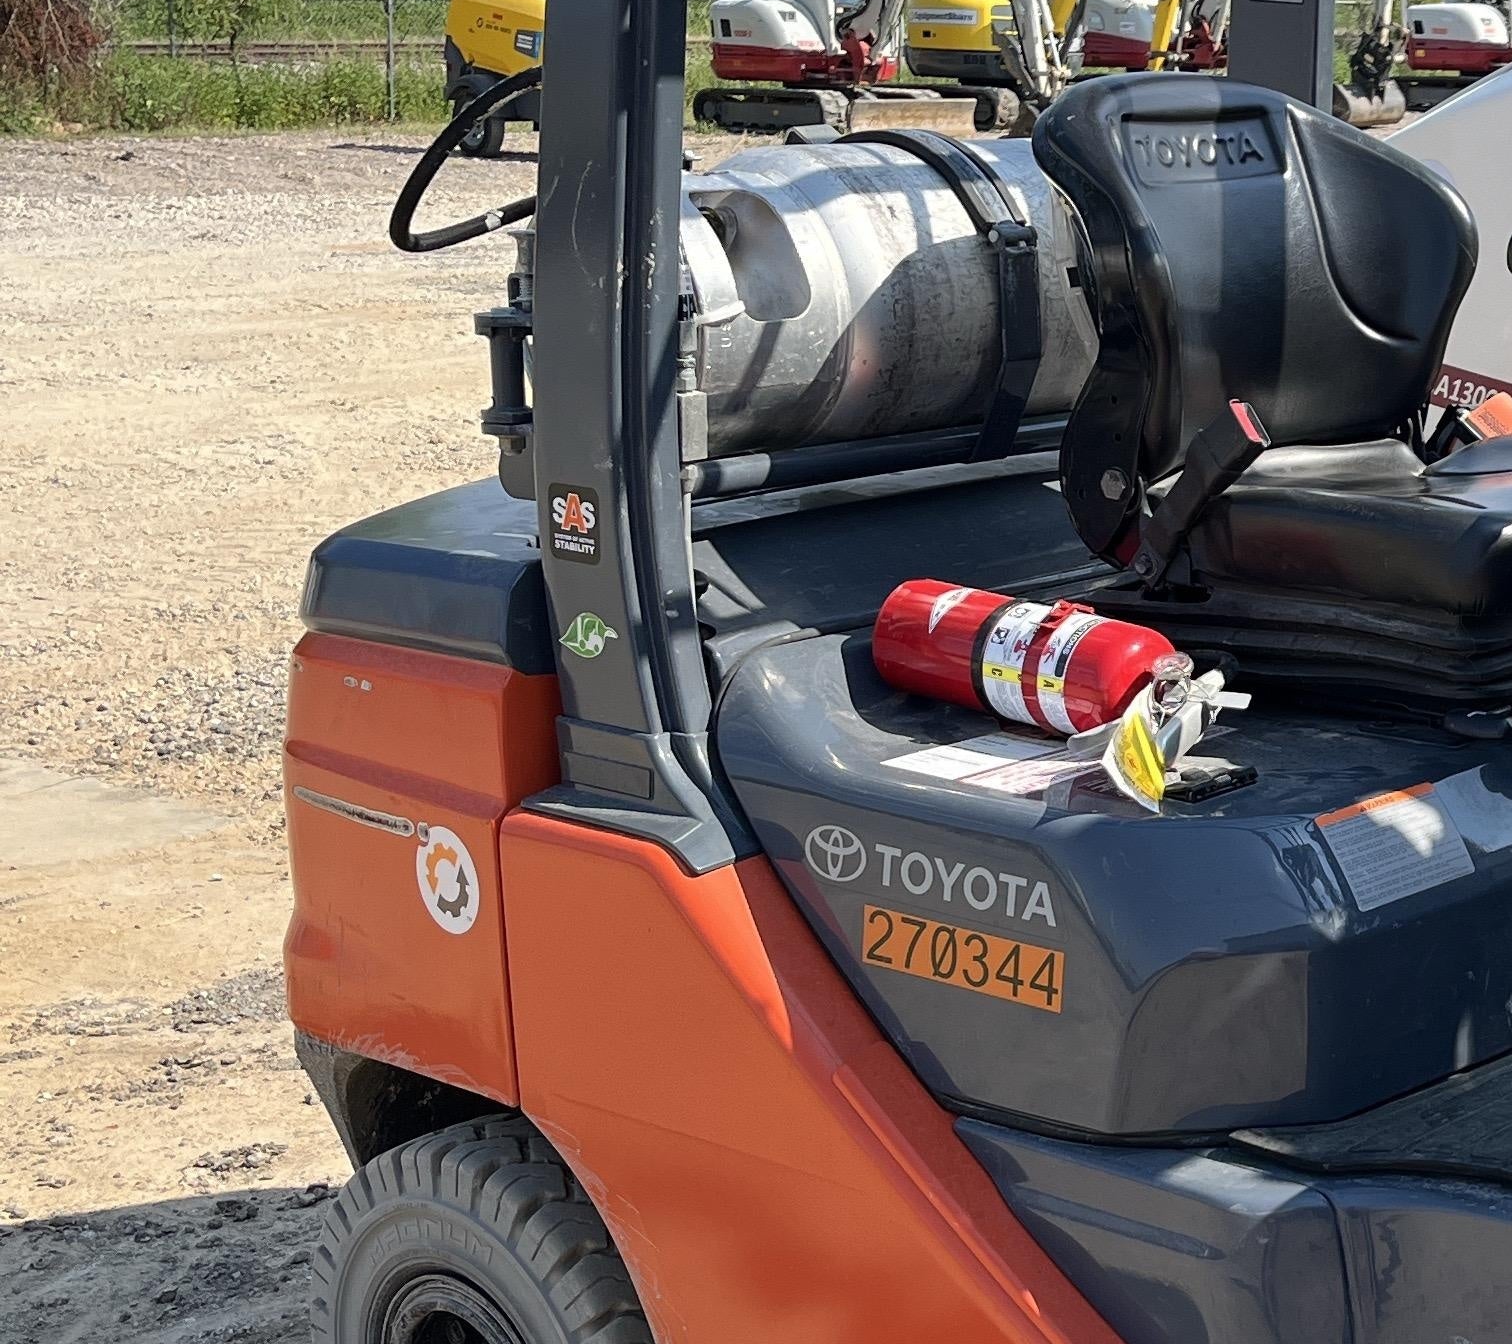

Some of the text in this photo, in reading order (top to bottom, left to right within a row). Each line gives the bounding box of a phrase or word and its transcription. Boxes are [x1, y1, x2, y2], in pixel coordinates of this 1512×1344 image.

[1134, 130, 1265, 168] TOYOTA
[551, 492, 596, 534] SAS
[554, 539, 595, 555] STABILITY
[874, 842, 1058, 928] TOYOTA
[865, 908, 1060, 1006] 270344
